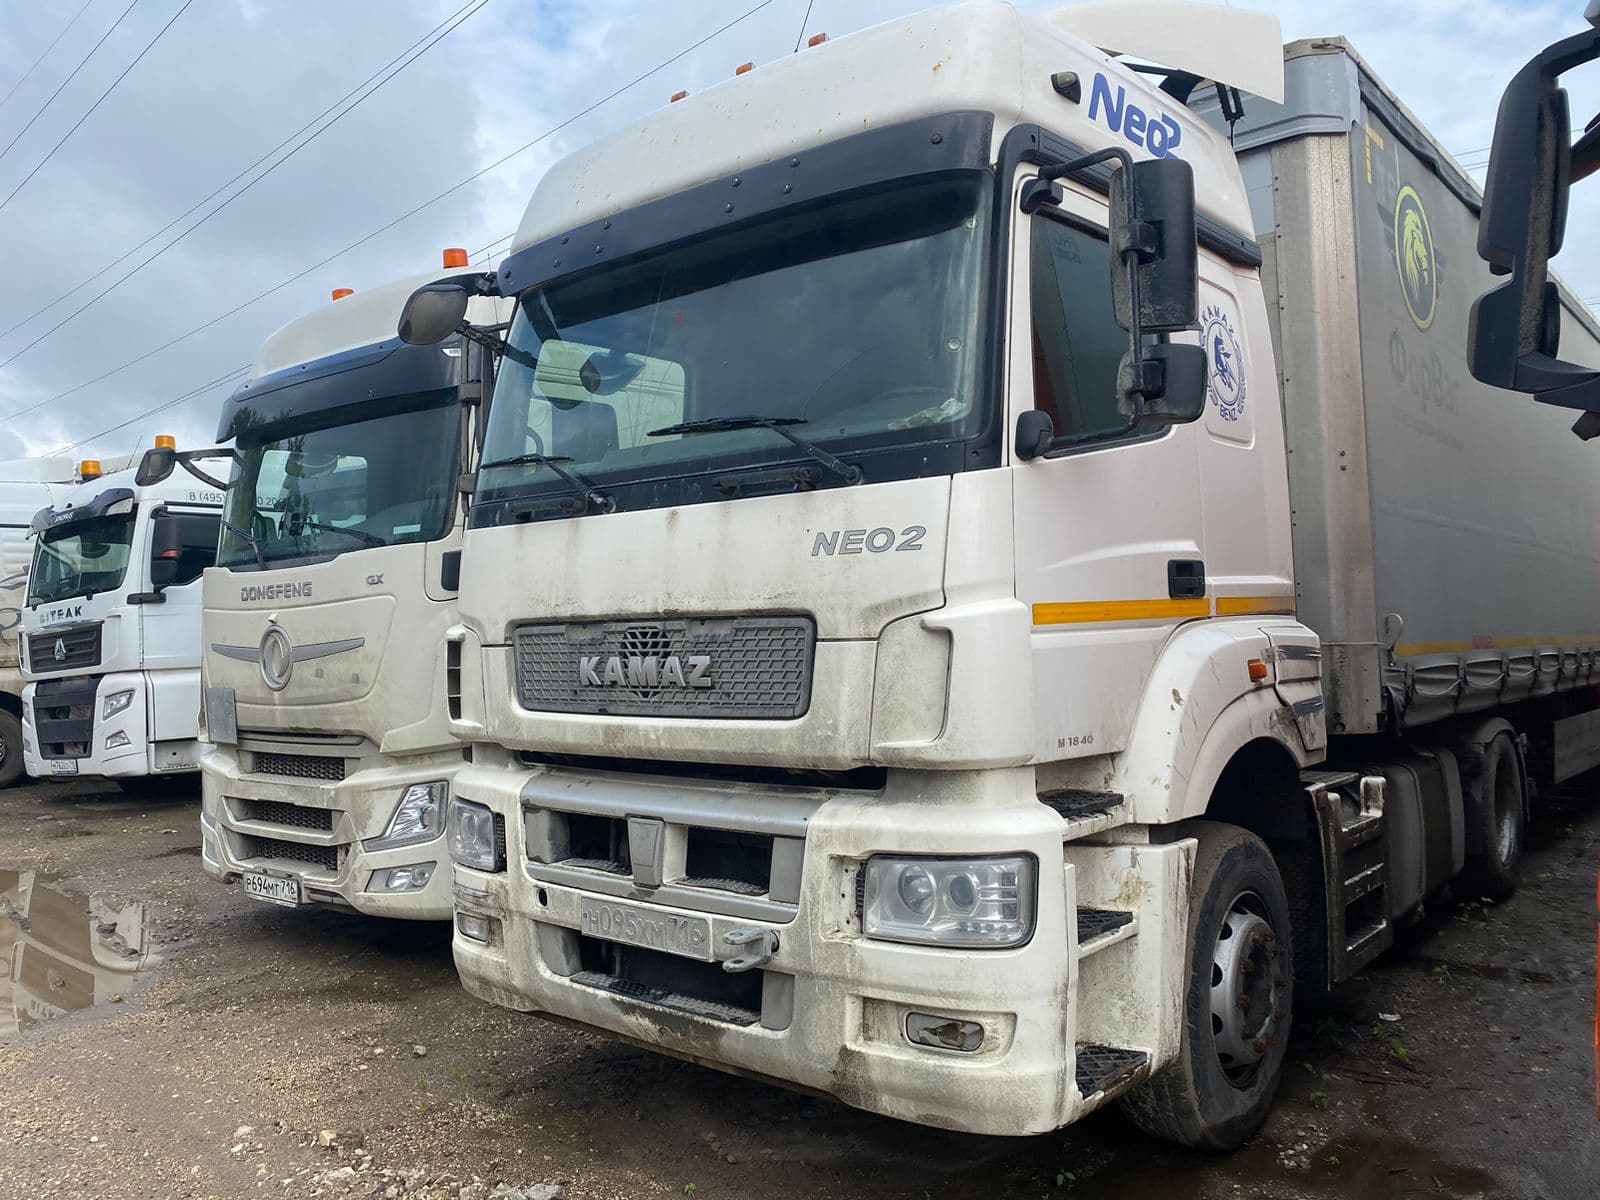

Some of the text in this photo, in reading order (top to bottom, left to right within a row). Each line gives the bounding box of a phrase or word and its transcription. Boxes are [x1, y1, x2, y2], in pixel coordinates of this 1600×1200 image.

[189, 491, 197, 501] 8
[811, 525, 927, 557] NEO2
[366, 573, 385, 586] GX
[240, 581, 313, 602] DONGFENG
[579, 655, 713, 688] KAMAZ
